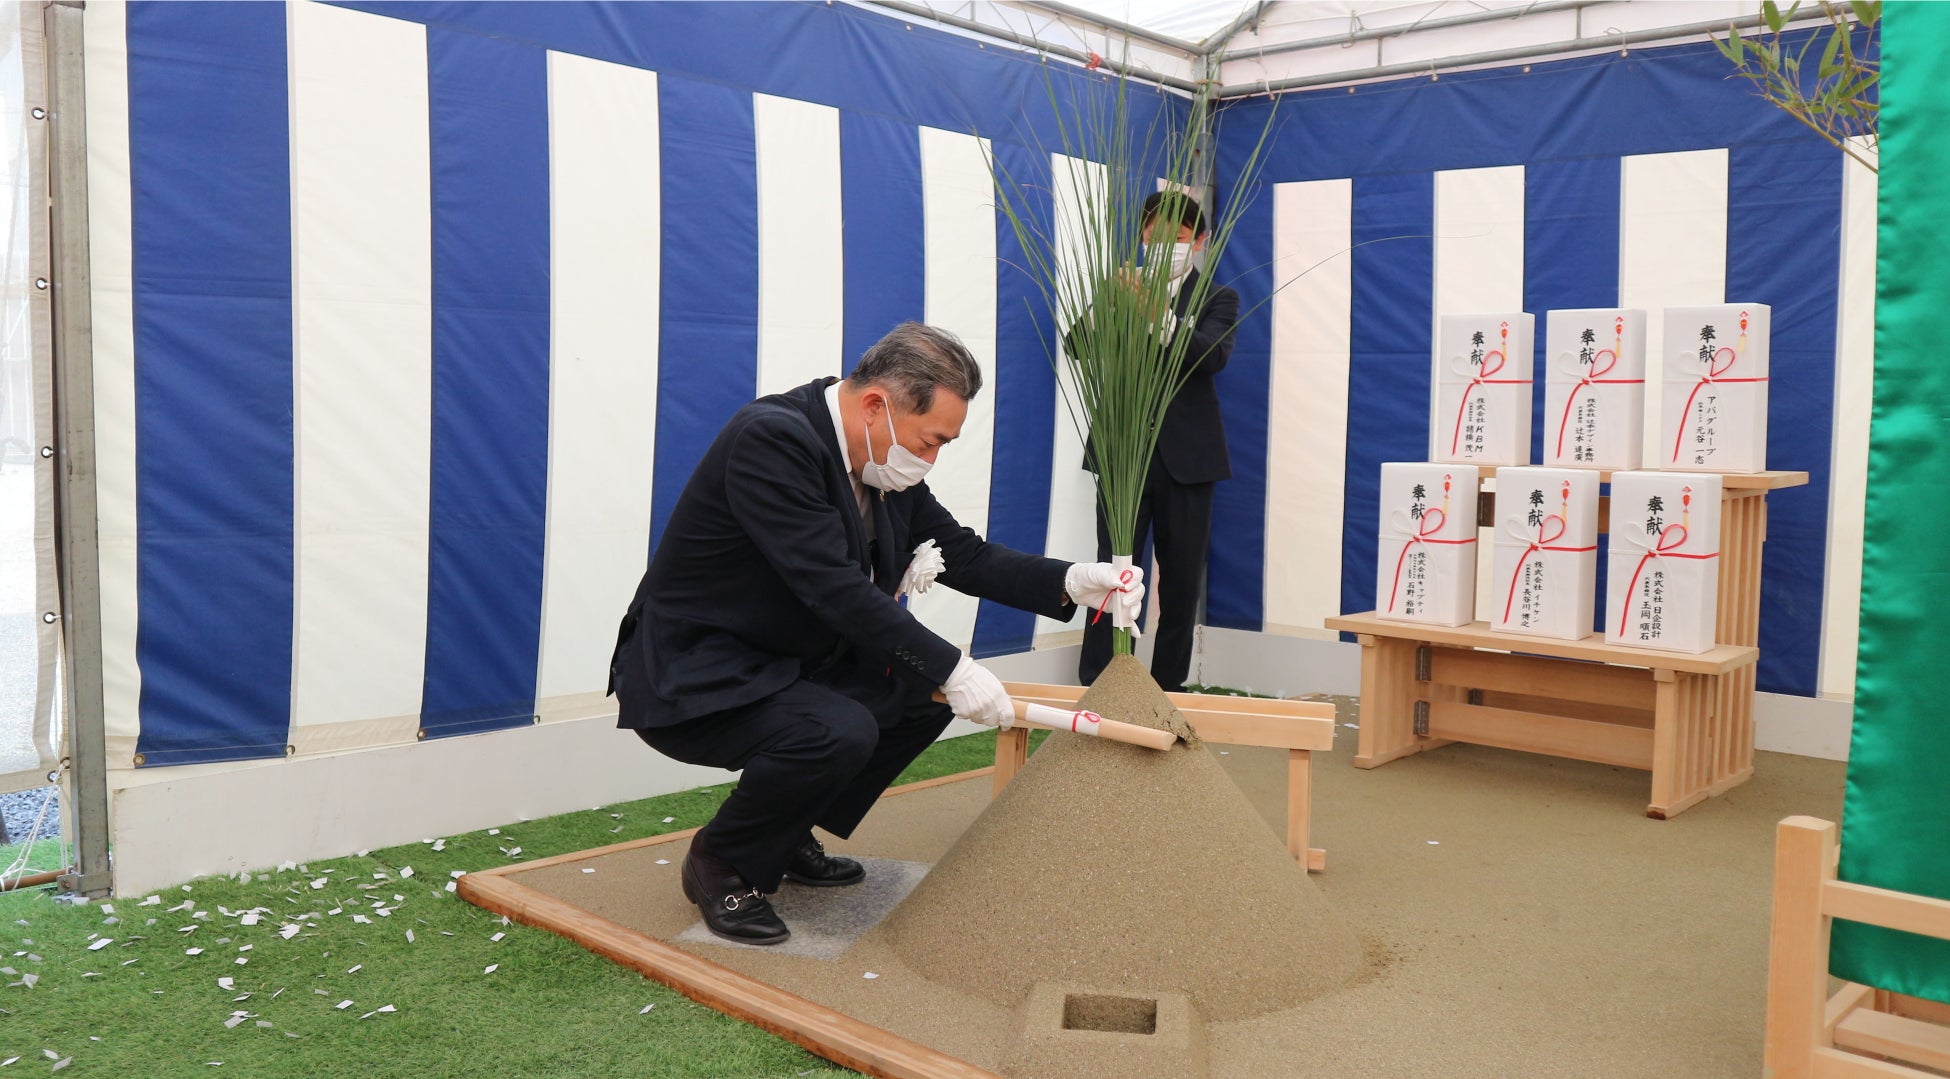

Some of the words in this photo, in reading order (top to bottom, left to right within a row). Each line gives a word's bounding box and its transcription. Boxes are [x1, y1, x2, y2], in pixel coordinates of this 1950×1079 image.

[1580, 328, 1596, 365] 奉献
[1699, 324, 1716, 363] 奉献
[1411, 484, 1426, 520] 奉献
[1528, 489, 1544, 527] 奉献
[1646, 495, 1664, 536] 奉献
